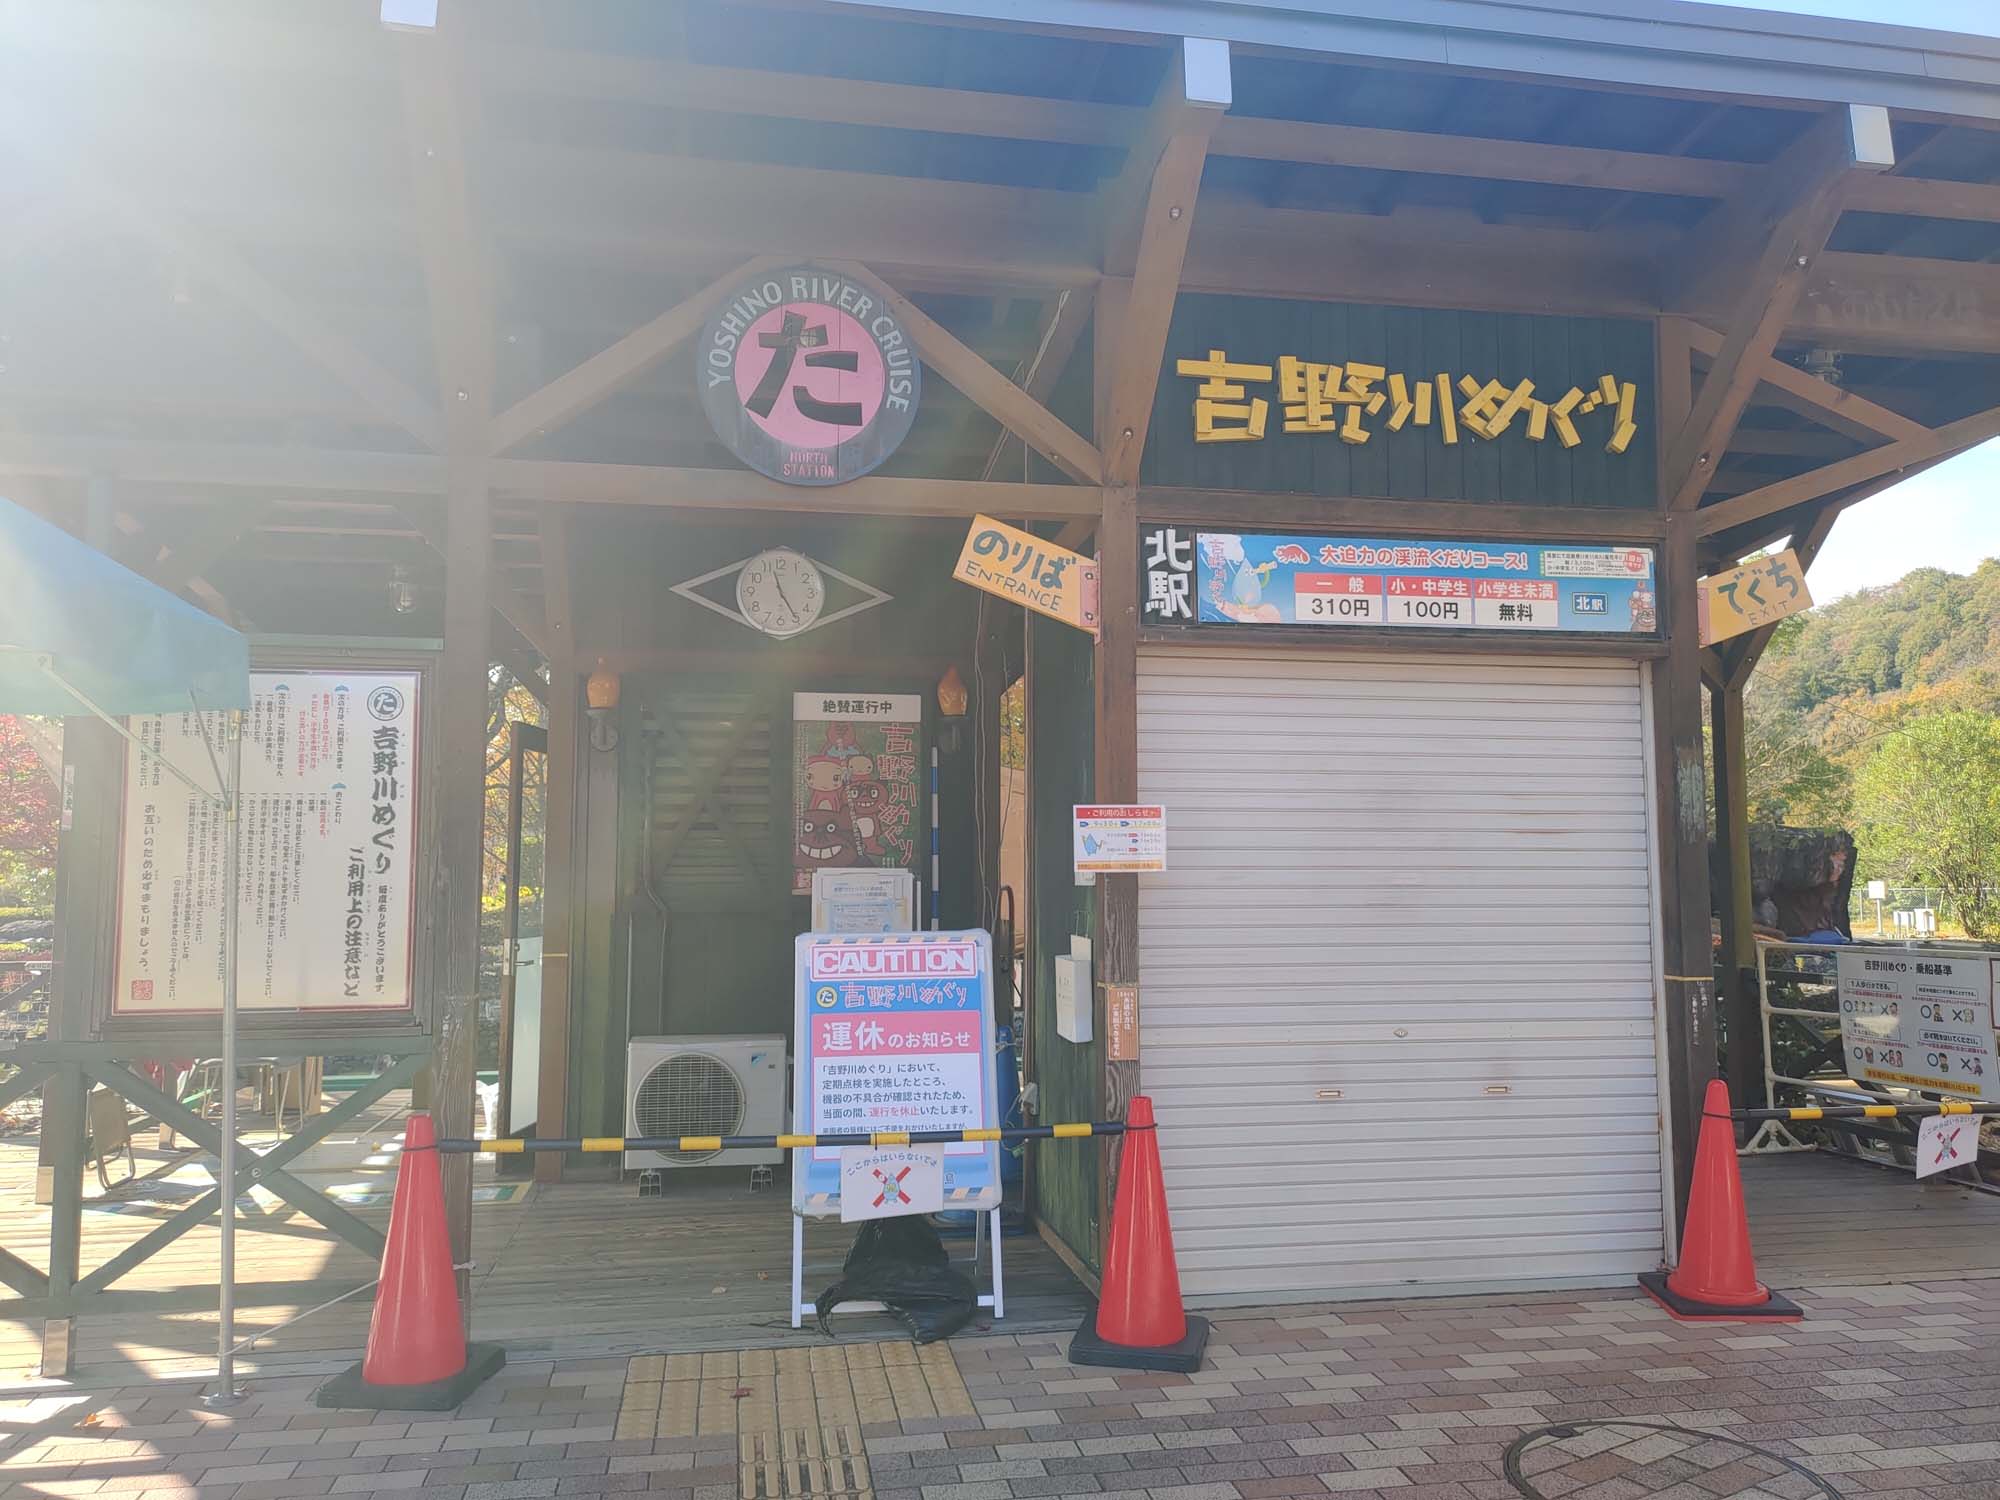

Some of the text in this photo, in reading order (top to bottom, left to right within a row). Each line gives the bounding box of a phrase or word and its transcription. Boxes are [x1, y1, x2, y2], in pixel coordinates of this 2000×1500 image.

[709, 276, 912, 413] YOSHINO RIVER CRUISE
[744, 311, 863, 426] た
[1176, 349, 1638, 454] 吉野川めぐり
[790, 451, 828, 463] NORTH
[783, 463, 835, 478] STATION
[776, 559, 786, 570] 12
[973, 530, 1076, 589] のりば
[751, 573, 761, 583] 10
[801, 573, 810, 584] 2
[1145, 528, 1193, 619] 北駅
[747, 586, 755, 597] 9
[807, 588, 815, 599] 3
[966, 560, 1063, 612] ENTRANCE
[1478, 582, 1555, 598] 小学生未満
[1717, 557, 1798, 614] でぐち
[752, 601, 760, 612] 8
[1311, 599, 1370, 617] 310円
[1403, 600, 1460, 619] 100円
[1499, 603, 1534, 622] 無料
[1748, 600, 1788, 625] EXIT
[777, 616, 785, 626] 6
[822, 700, 893, 714] 絶賛運行中
[372, 725, 400, 875] 吉野川めぐり
[344, 847, 366, 998] ご利用上の注意など
[817, 946, 971, 977] CAUTION
[840, 981, 968, 1009] 吉野川めぐり
[822, 1021, 971, 1051] 運休のお知らせ
[822, 1062, 941, 1076] 「吉野川めぐり」において、
[822, 1077, 946, 1090] 定期点検を実施したところ、
[822, 1091, 966, 1104] 機器の不具合が確認されたため、
[823, 1104, 973, 1119] 当面の間、運行を休止いたします。
